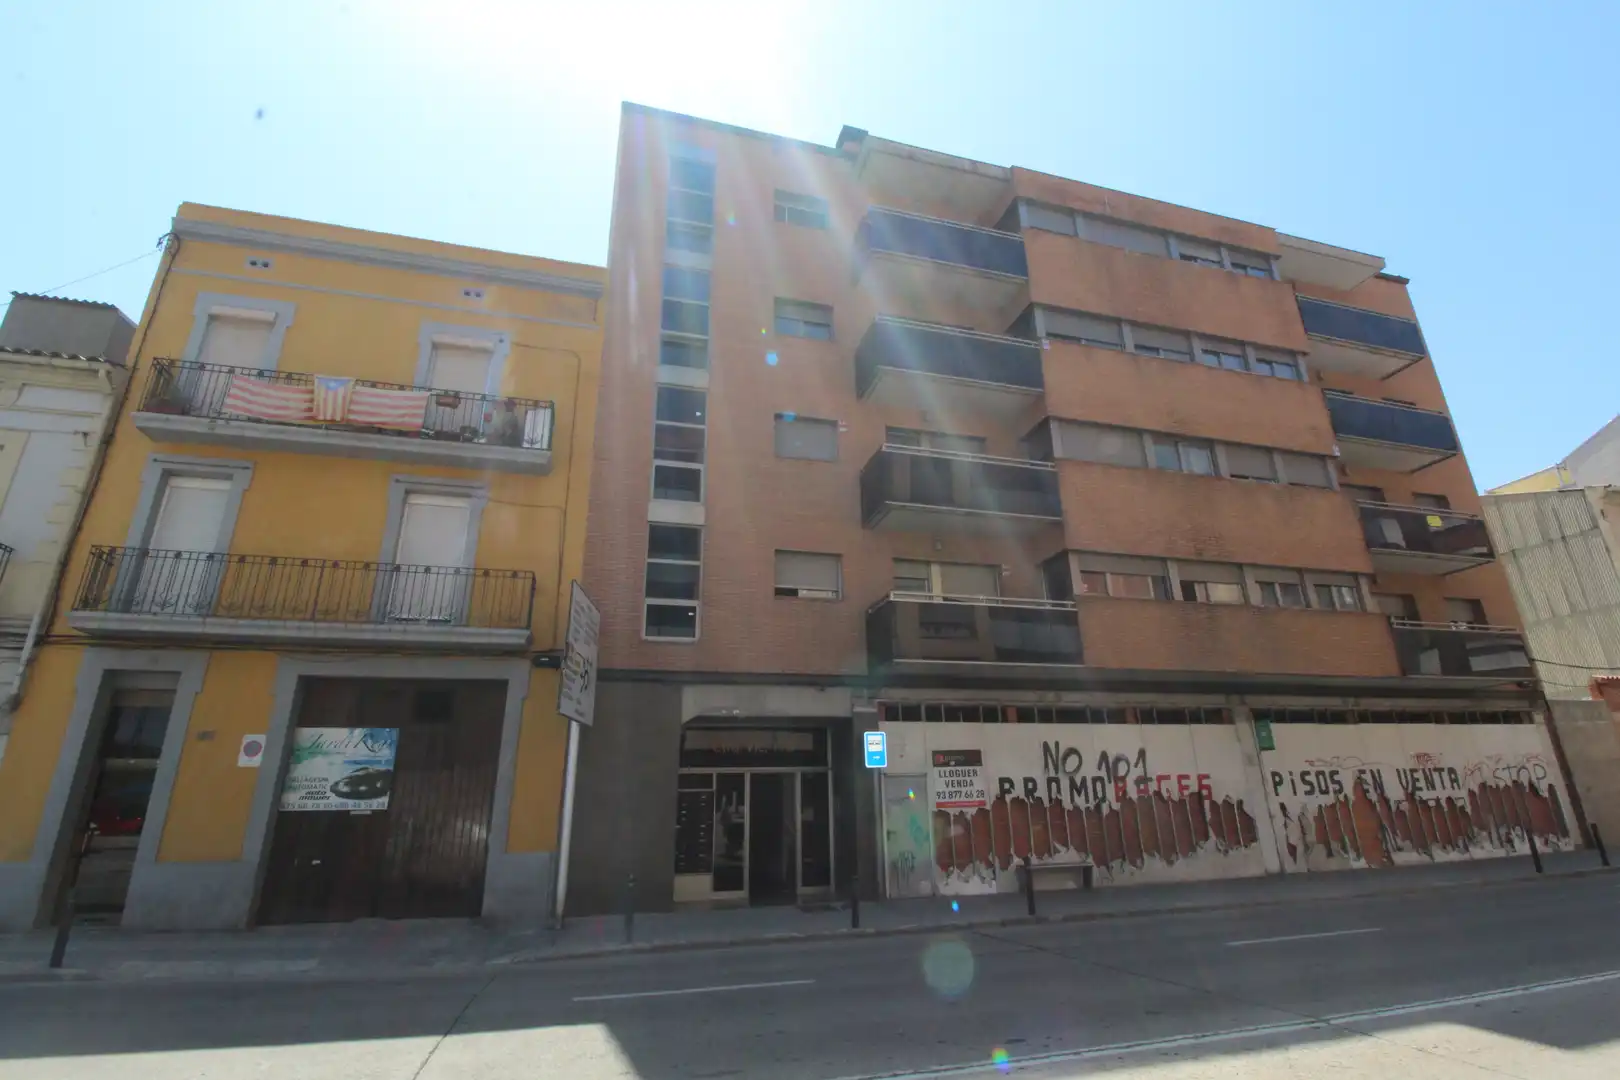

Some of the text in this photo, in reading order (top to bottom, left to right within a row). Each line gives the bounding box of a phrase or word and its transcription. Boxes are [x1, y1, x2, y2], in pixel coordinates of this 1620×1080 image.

[1043, 740, 1082, 776] NO
[938, 769, 978, 778] LLOGUER
[944, 779, 974, 788] VENDA
[1356, 768, 1385, 798] EN
[1396, 766, 1461, 792] VENTA
[936, 791, 946, 800] 93
[948, 790, 962, 799] 877
